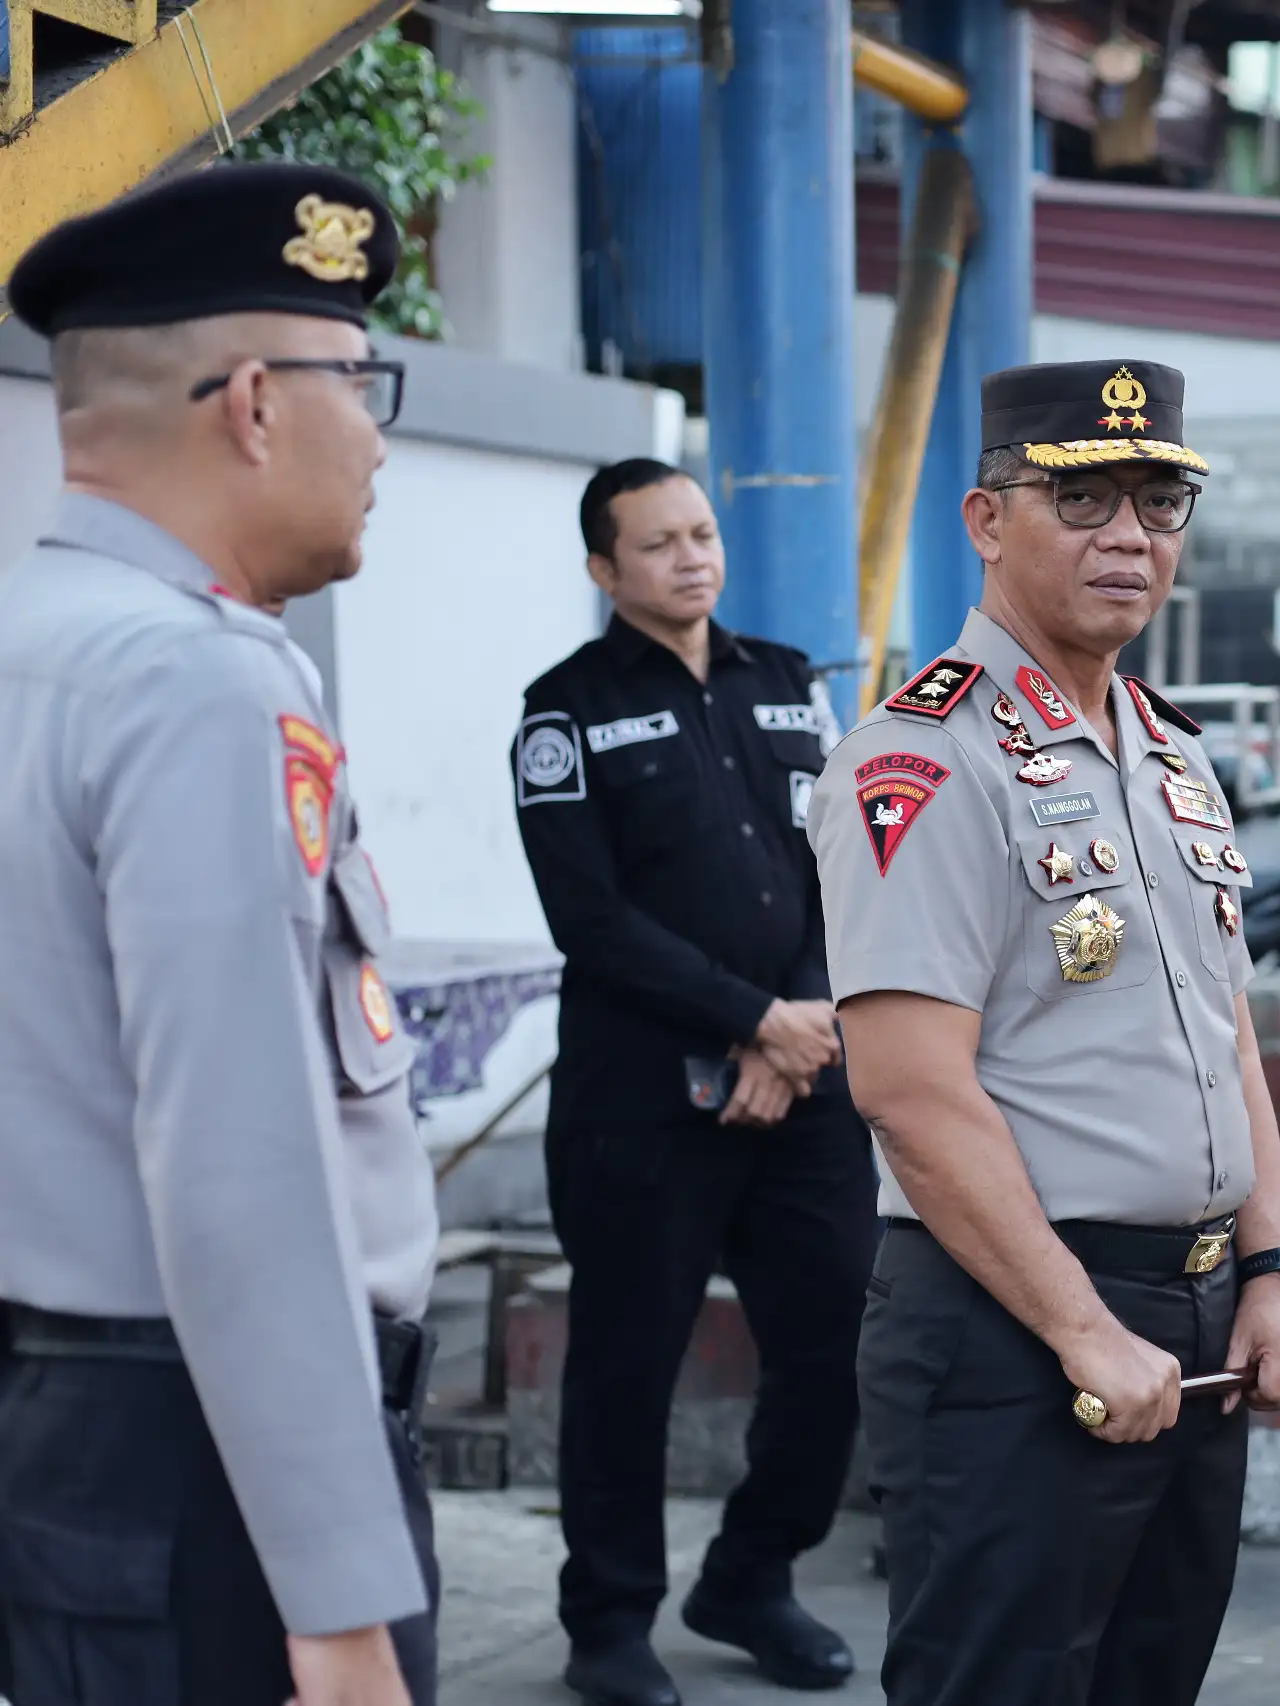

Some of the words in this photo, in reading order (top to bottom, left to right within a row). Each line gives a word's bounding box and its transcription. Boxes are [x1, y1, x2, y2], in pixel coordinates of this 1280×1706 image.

[863, 757, 937, 776] PELOPOR
[862, 784, 890, 800] KORPS
[894, 784, 925, 800] BRIMOB
[1041, 798, 1092, 815] S.NAINGGOLAN
